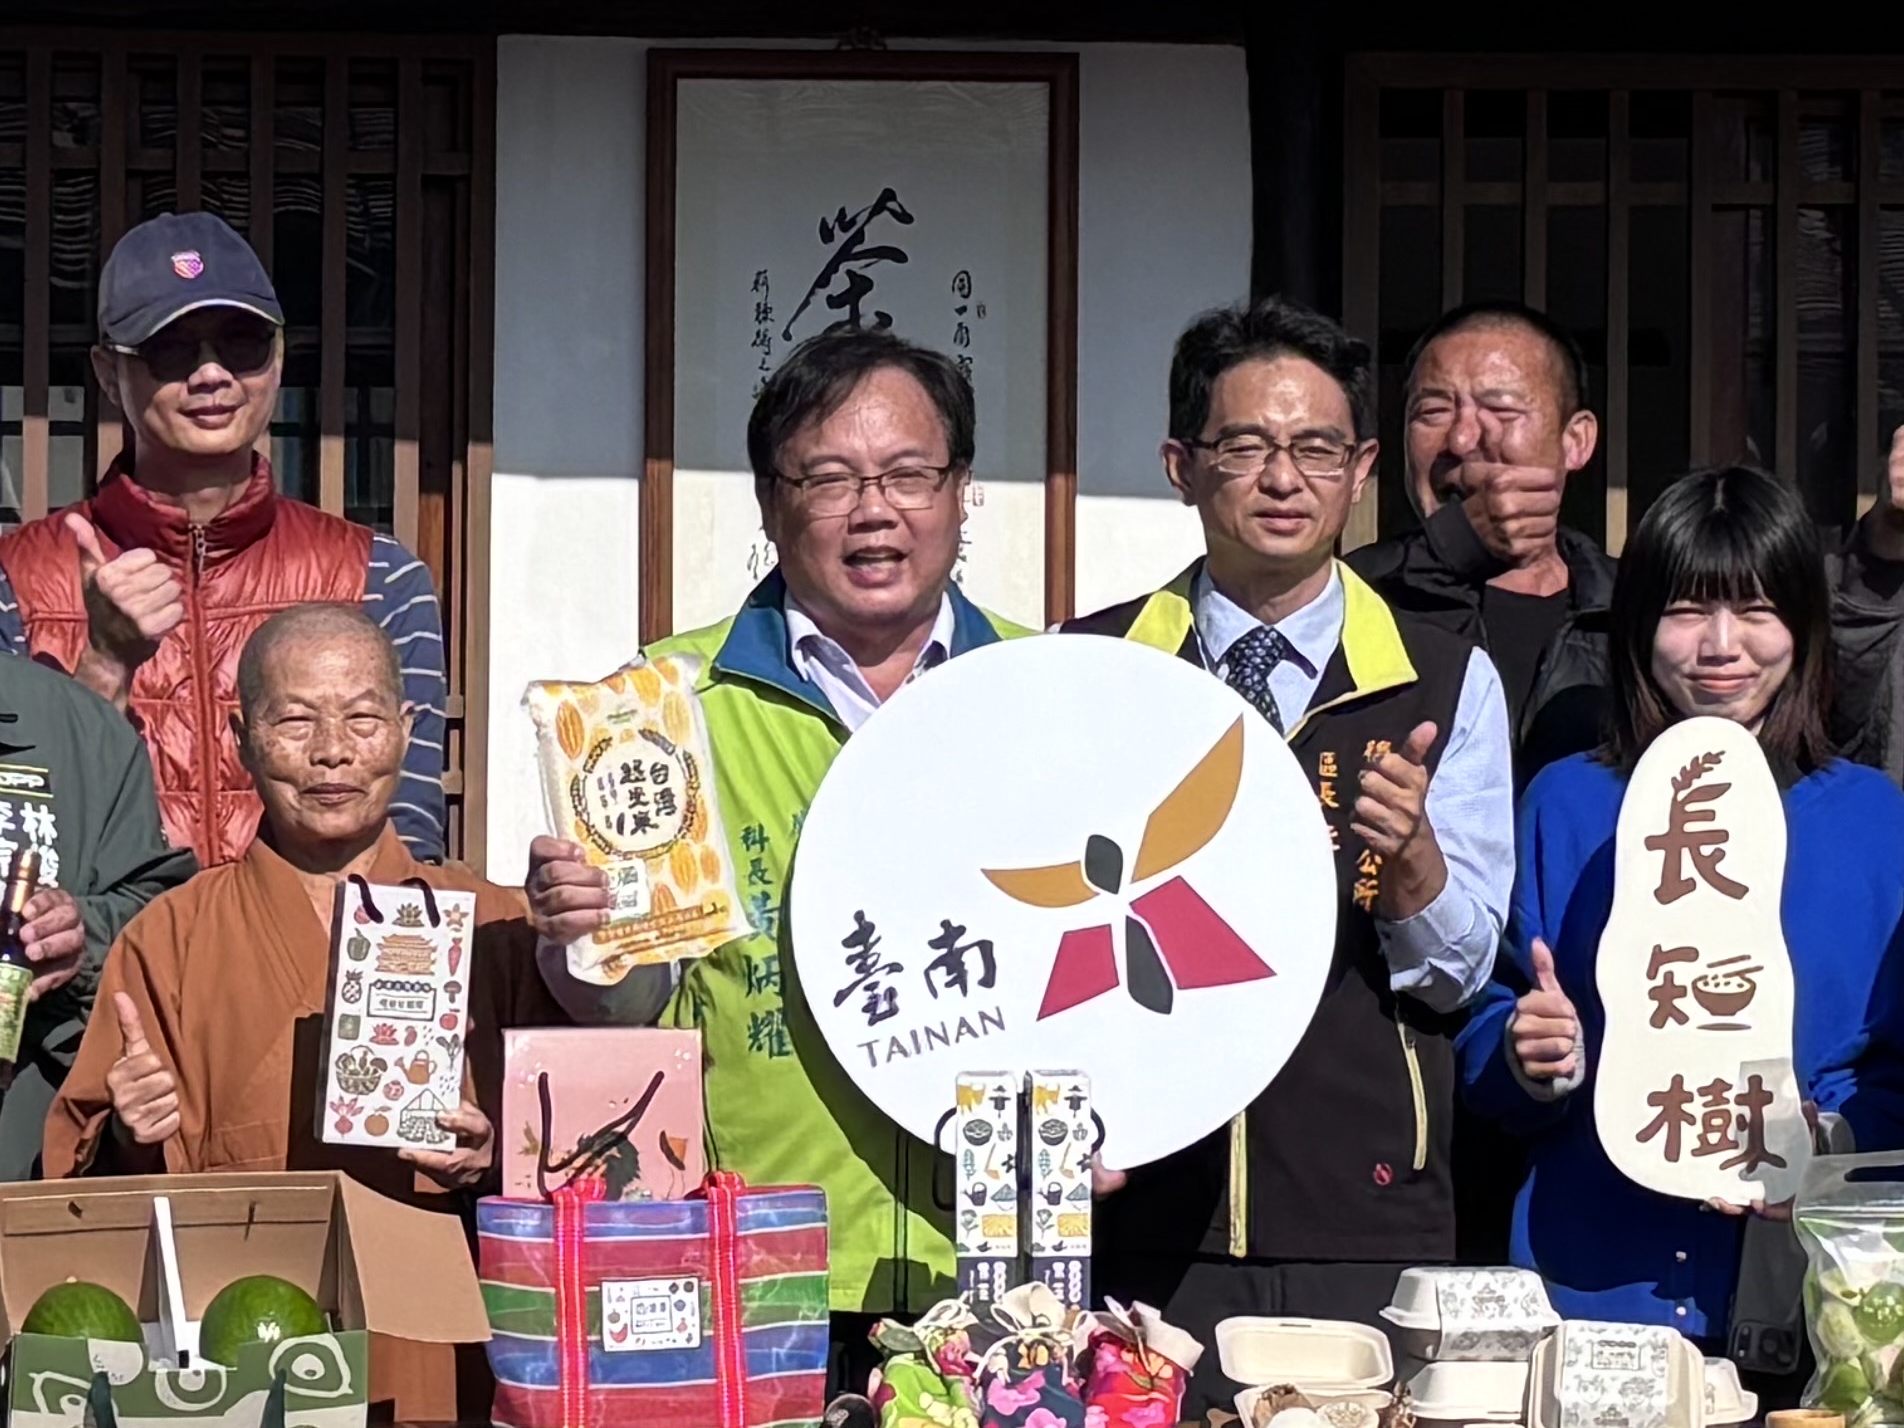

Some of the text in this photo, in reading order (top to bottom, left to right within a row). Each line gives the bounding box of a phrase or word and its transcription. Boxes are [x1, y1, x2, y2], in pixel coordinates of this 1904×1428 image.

[833, 909, 998, 1027] 臺南
[1635, 750, 1788, 1175] 長短樹
[856, 1005, 1006, 1069] TAINAN
